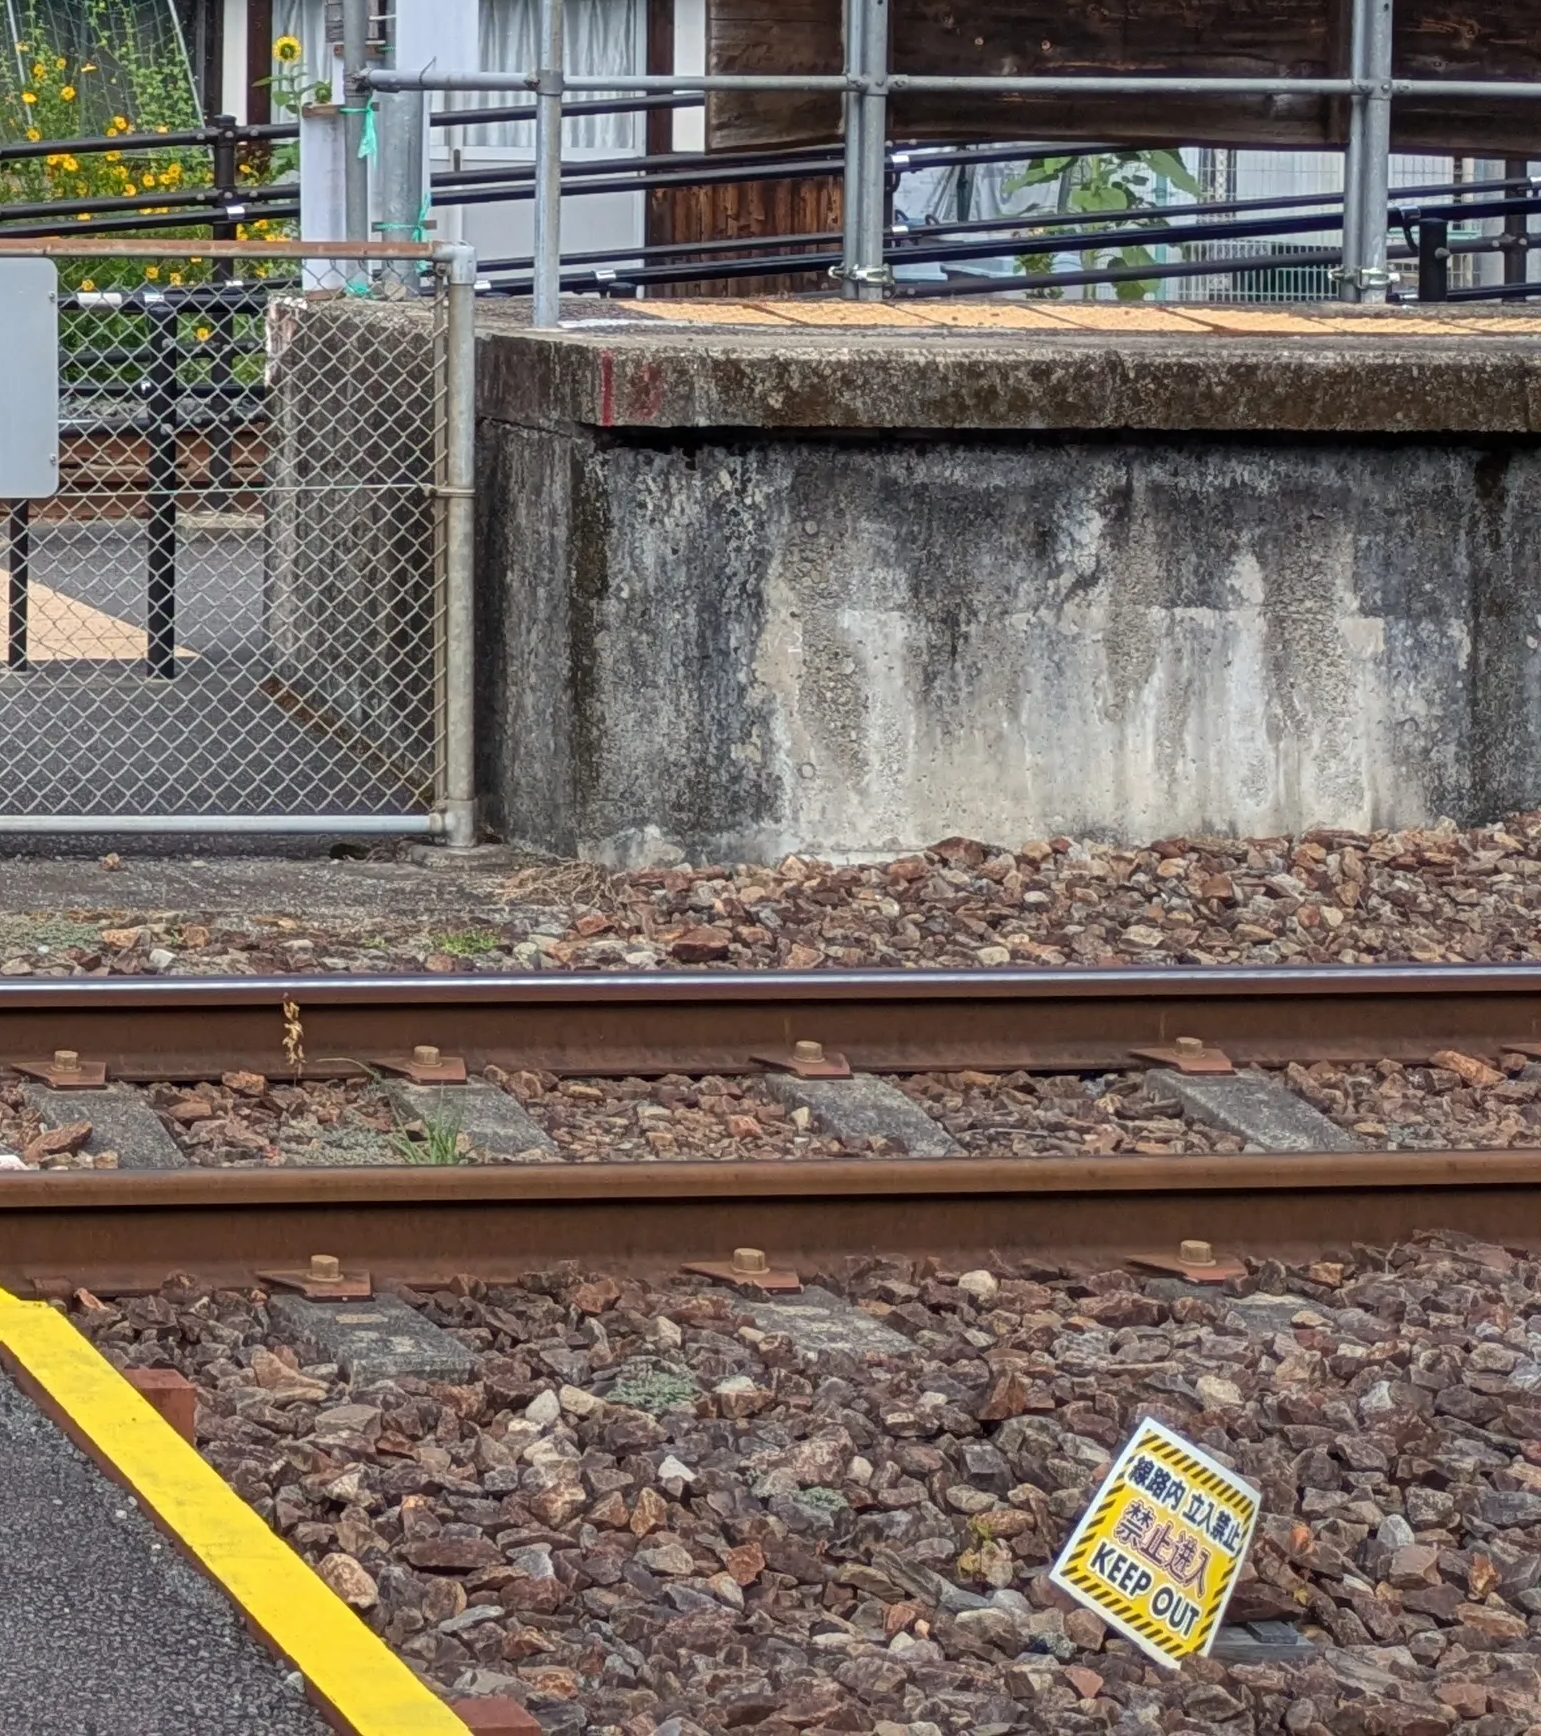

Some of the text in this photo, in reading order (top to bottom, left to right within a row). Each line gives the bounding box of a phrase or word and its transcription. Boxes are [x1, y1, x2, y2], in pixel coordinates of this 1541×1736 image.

[1115, 1499, 1210, 1598] 禁止进入
[1127, 1455, 1242, 1554] 線路内 立入禁止
[1089, 1541, 1201, 1638] KEEP OUT
